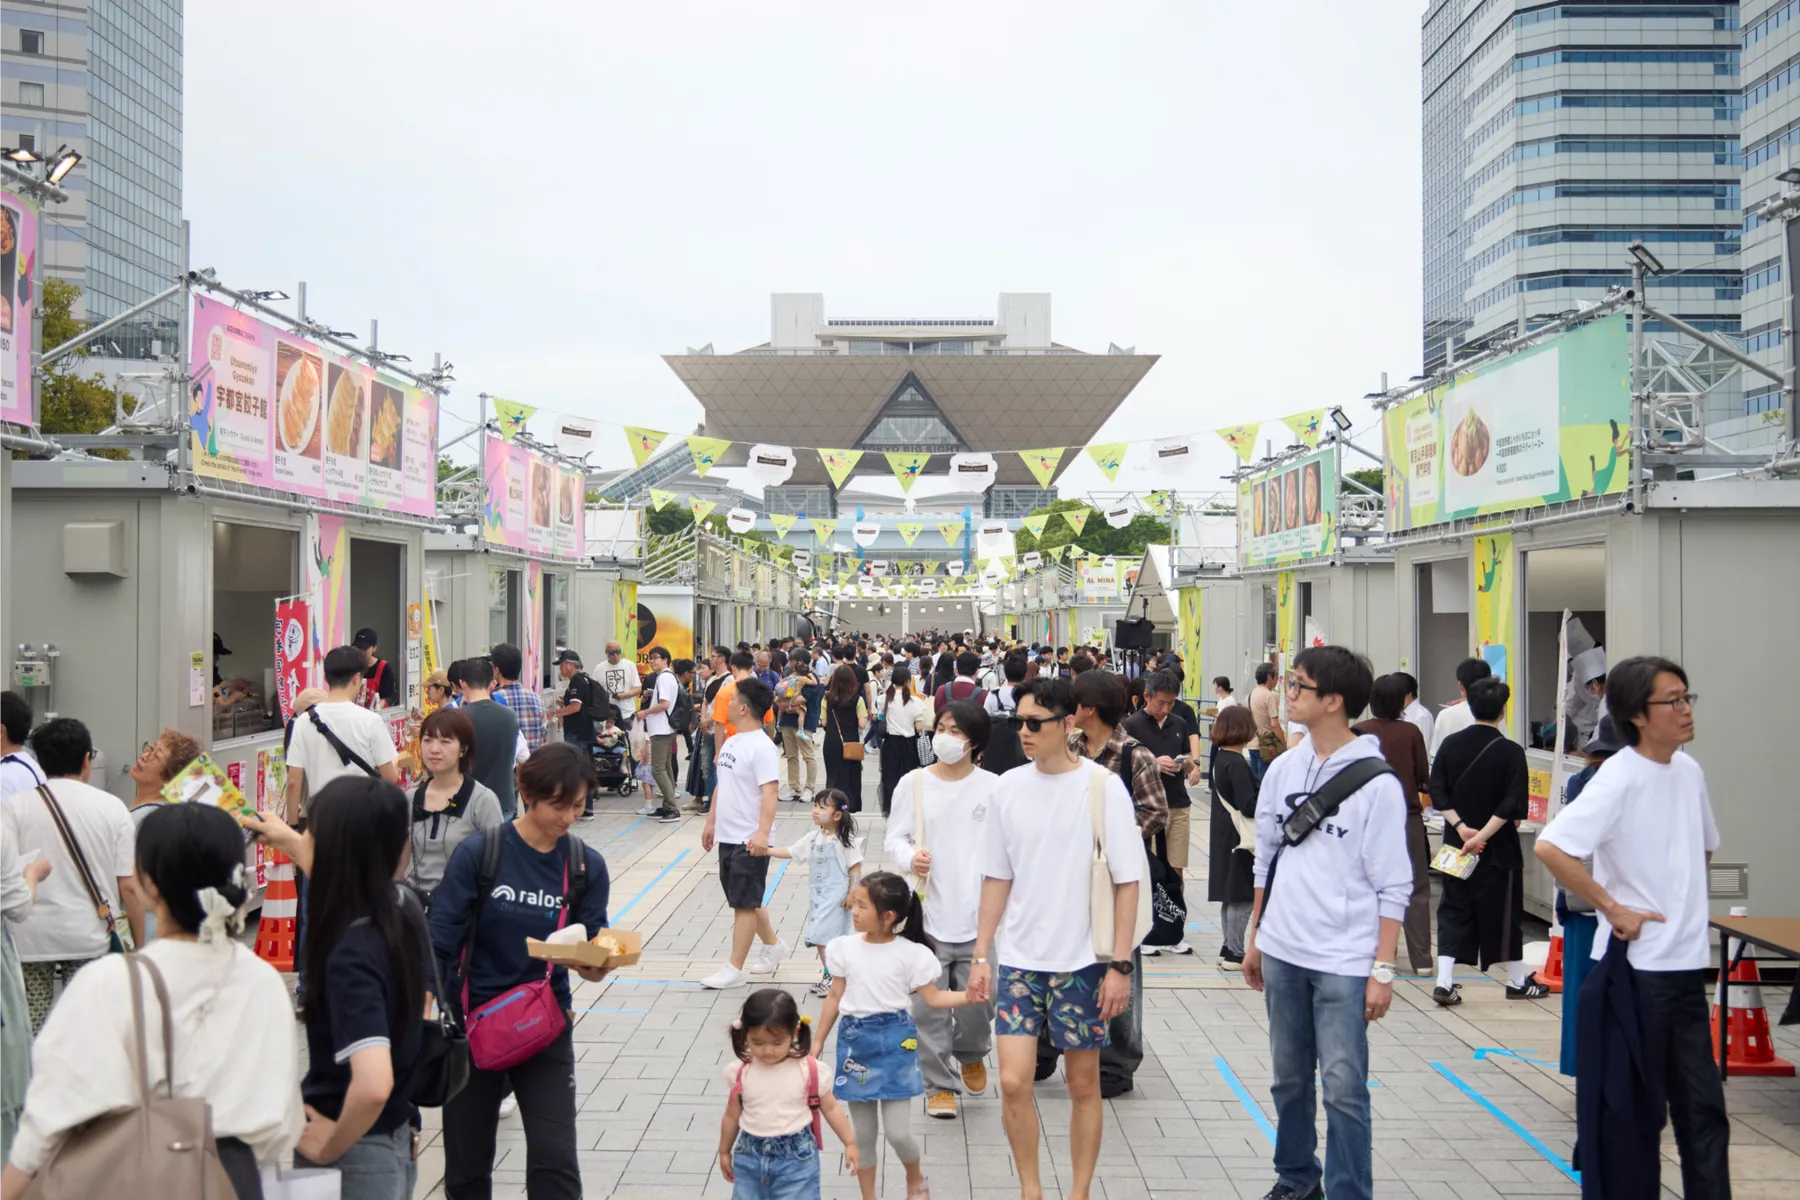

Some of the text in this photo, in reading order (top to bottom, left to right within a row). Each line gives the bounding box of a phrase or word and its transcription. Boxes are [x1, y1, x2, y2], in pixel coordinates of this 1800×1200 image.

[230, 355, 258, 374] Utsunomiya
[232, 370, 255, 386] Gyozakan
[216, 384, 268, 420] 宇都宮餃子館
[861, 445, 960, 453] TOKYO BIG SIGHT
